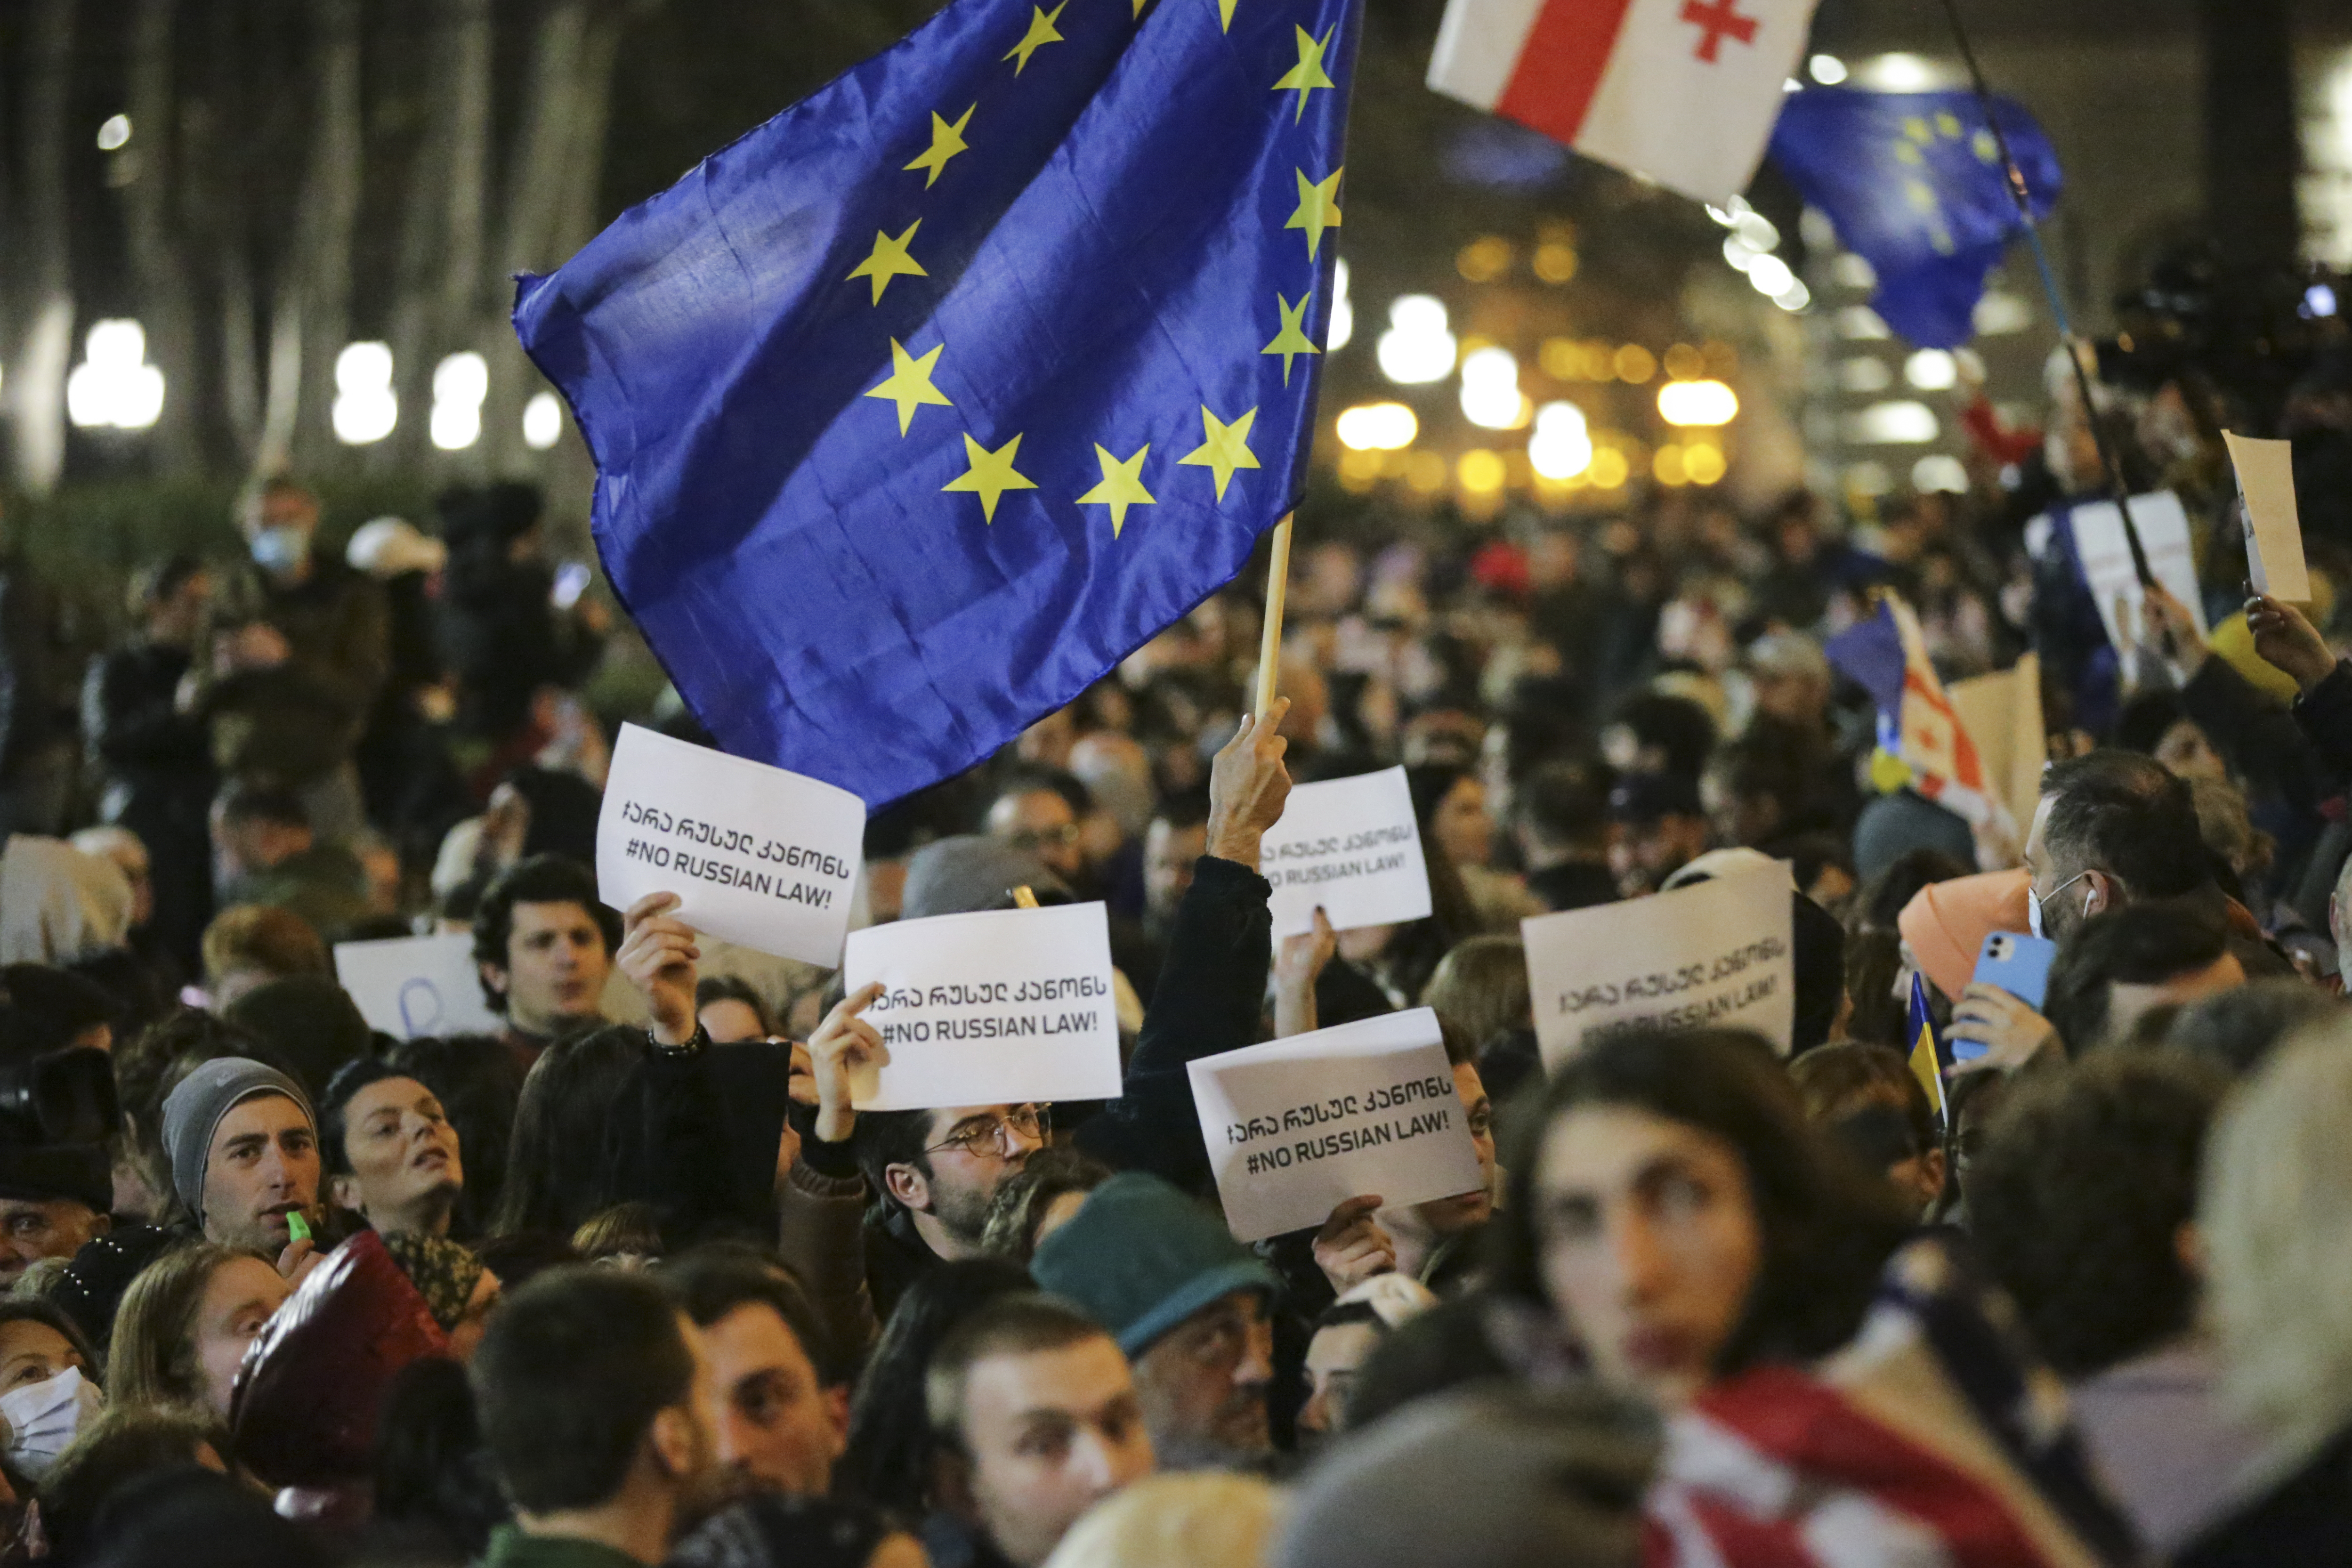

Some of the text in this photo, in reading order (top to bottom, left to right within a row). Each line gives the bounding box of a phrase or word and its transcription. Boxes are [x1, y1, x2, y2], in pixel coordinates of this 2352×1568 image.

[626, 838, 832, 909] #NO RUSSIAN LAW!
[677, 819, 753, 855] რუსულ
[757, 841, 849, 879] კანონს
[1286, 862, 1361, 883] RUSSIAN
[929, 982, 1007, 1005] რუსულ
[1014, 975, 1107, 1002] კანონს
[883, 1011, 1096, 1043] #NO RUSSIAN LAW!
[1284, 1096, 1358, 1131] რუსულ
[1364, 1076, 1452, 1112] კანონს
[1247, 1110, 1449, 1174] #NO RUSSIAN LAW!
